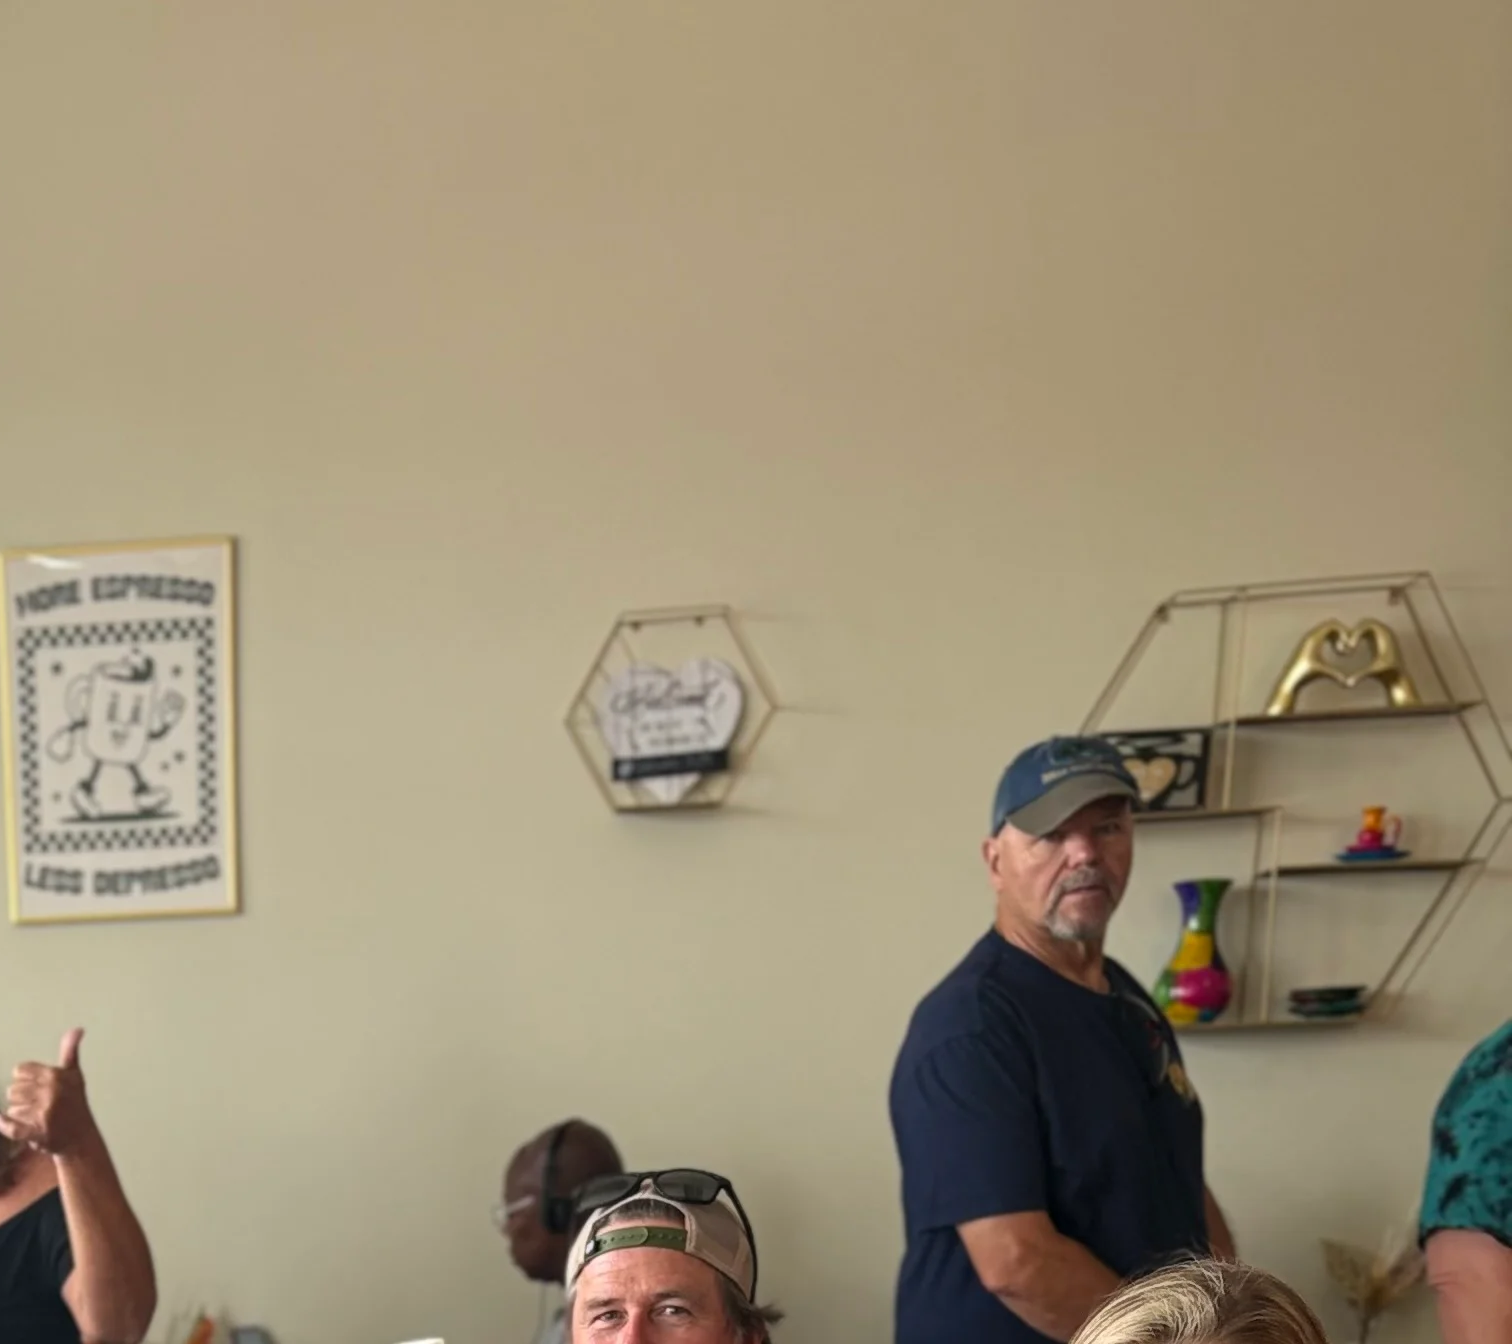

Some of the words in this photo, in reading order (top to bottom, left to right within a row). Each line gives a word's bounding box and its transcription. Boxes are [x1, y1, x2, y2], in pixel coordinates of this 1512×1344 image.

[15, 578, 81, 618] MORE
[91, 574, 215, 607] ESPRESSO
[24, 861, 83, 894] LESS
[93, 854, 220, 895] DEPRESSO
